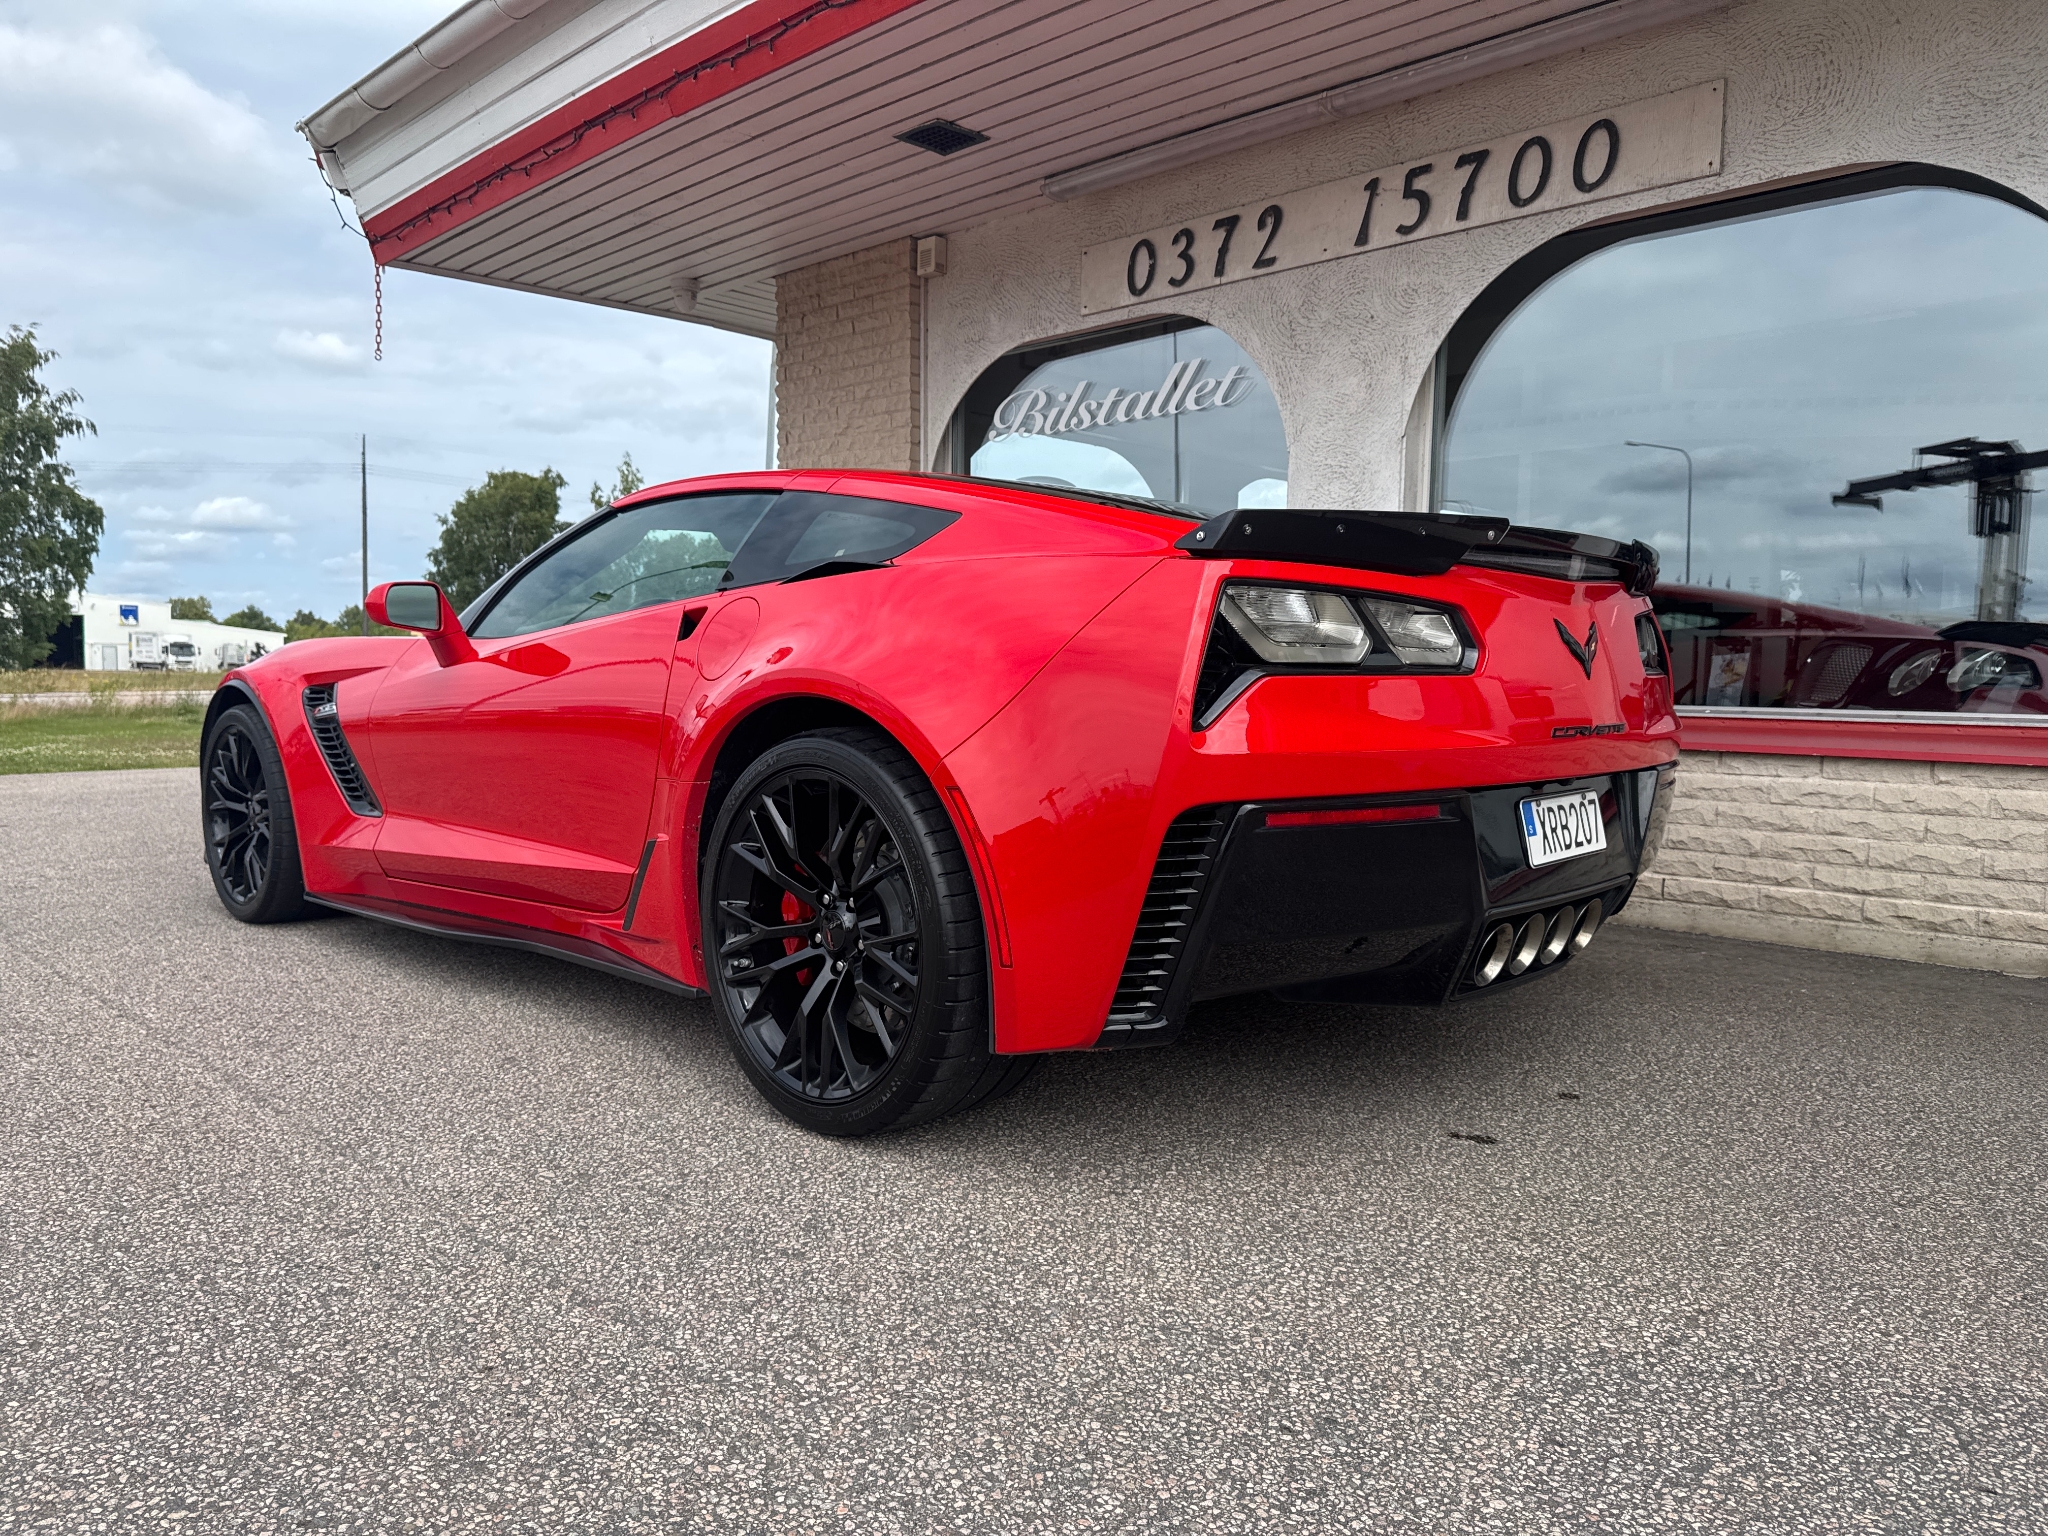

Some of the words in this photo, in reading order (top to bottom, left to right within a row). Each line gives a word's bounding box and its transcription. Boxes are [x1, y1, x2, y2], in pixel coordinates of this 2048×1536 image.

[1126, 205, 1282, 298] 0372
[1354, 118, 1620, 247] 15700
[988, 357, 1248, 442] Bilstallet
[1552, 723, 1625, 738] CORVETTE
[1529, 826, 1534, 834] S
[1535, 799, 1599, 855] XRB207
